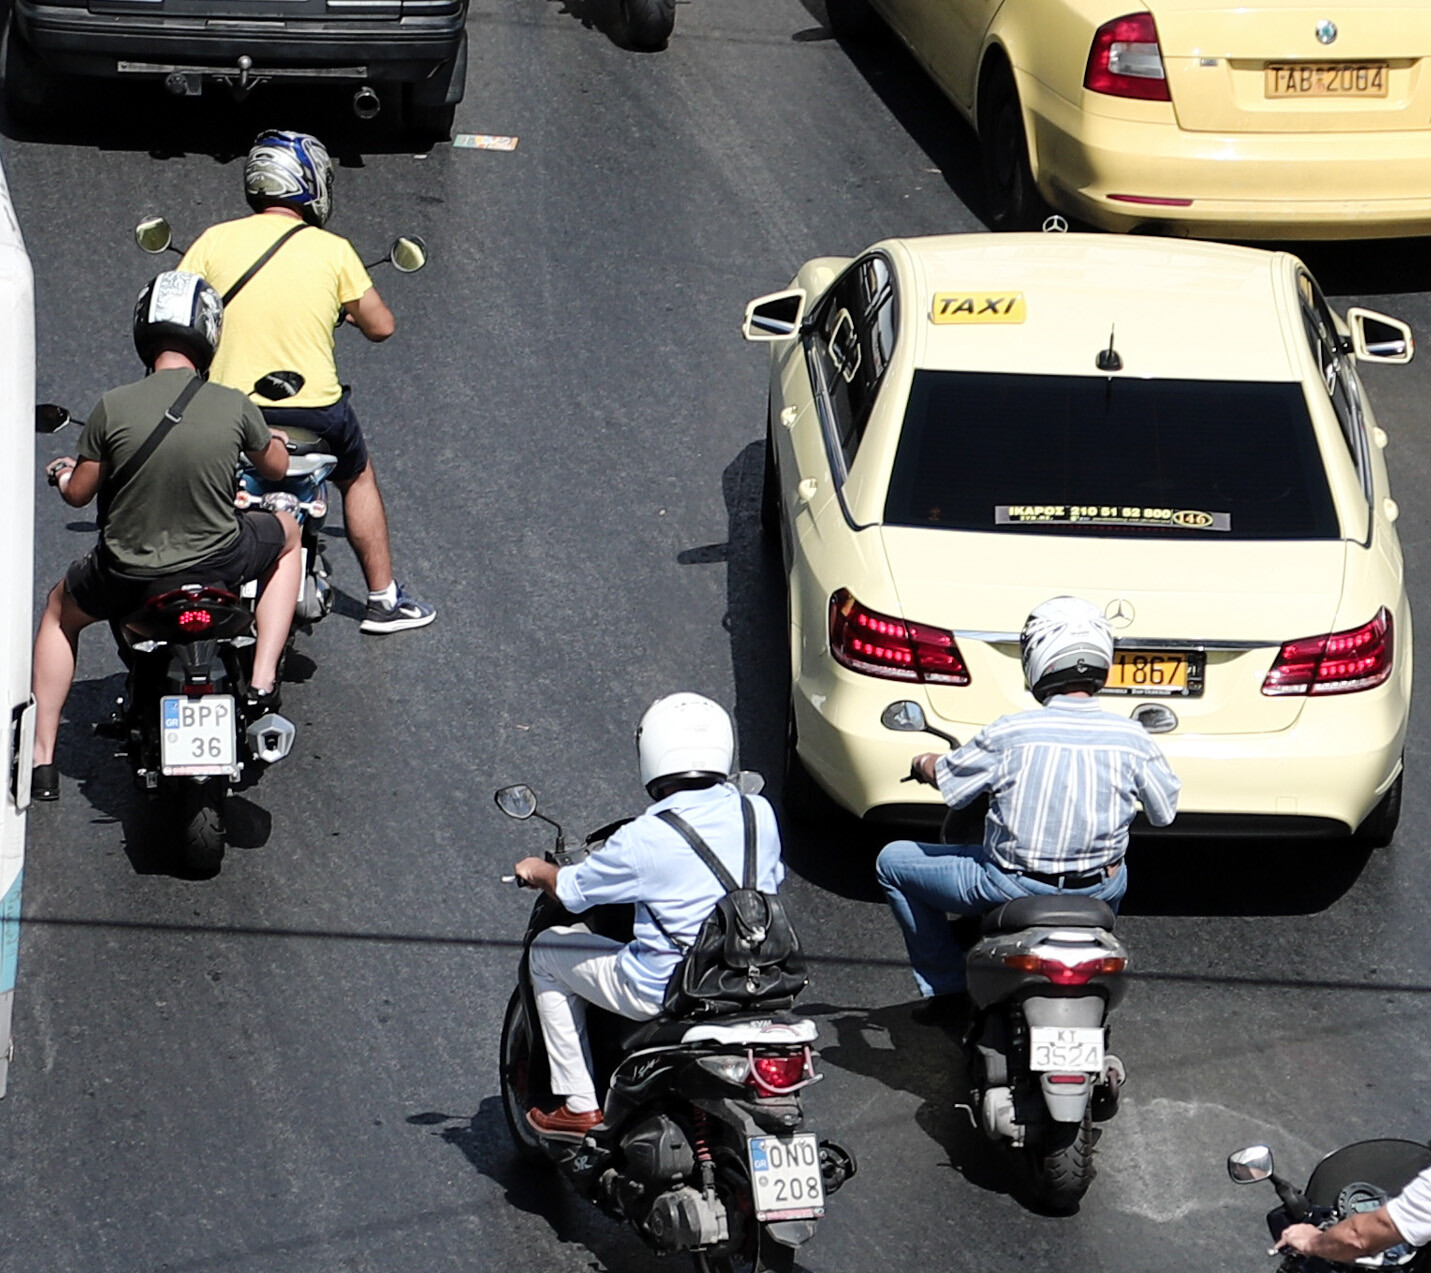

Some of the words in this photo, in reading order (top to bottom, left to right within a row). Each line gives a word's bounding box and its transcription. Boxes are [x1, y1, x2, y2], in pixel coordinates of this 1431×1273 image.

[939, 297, 1017, 315] TAXI
[1009, 506, 1065, 516] ΙΚΑΡΟΣ
[1070, 506, 1097, 517] 210
[1100, 507, 1117, 517] 51
[1122, 508, 1140, 518] 52
[1143, 508, 1171, 520] 800
[1178, 512, 1206, 525] 146
[182, 705, 228, 727] BPP
[191, 737, 221, 758] 36
[1057, 1031, 1075, 1042] KT
[1036, 1046, 1098, 1067] 3524
[769, 1142, 815, 1168] ONO
[773, 1177, 819, 1201] 208
